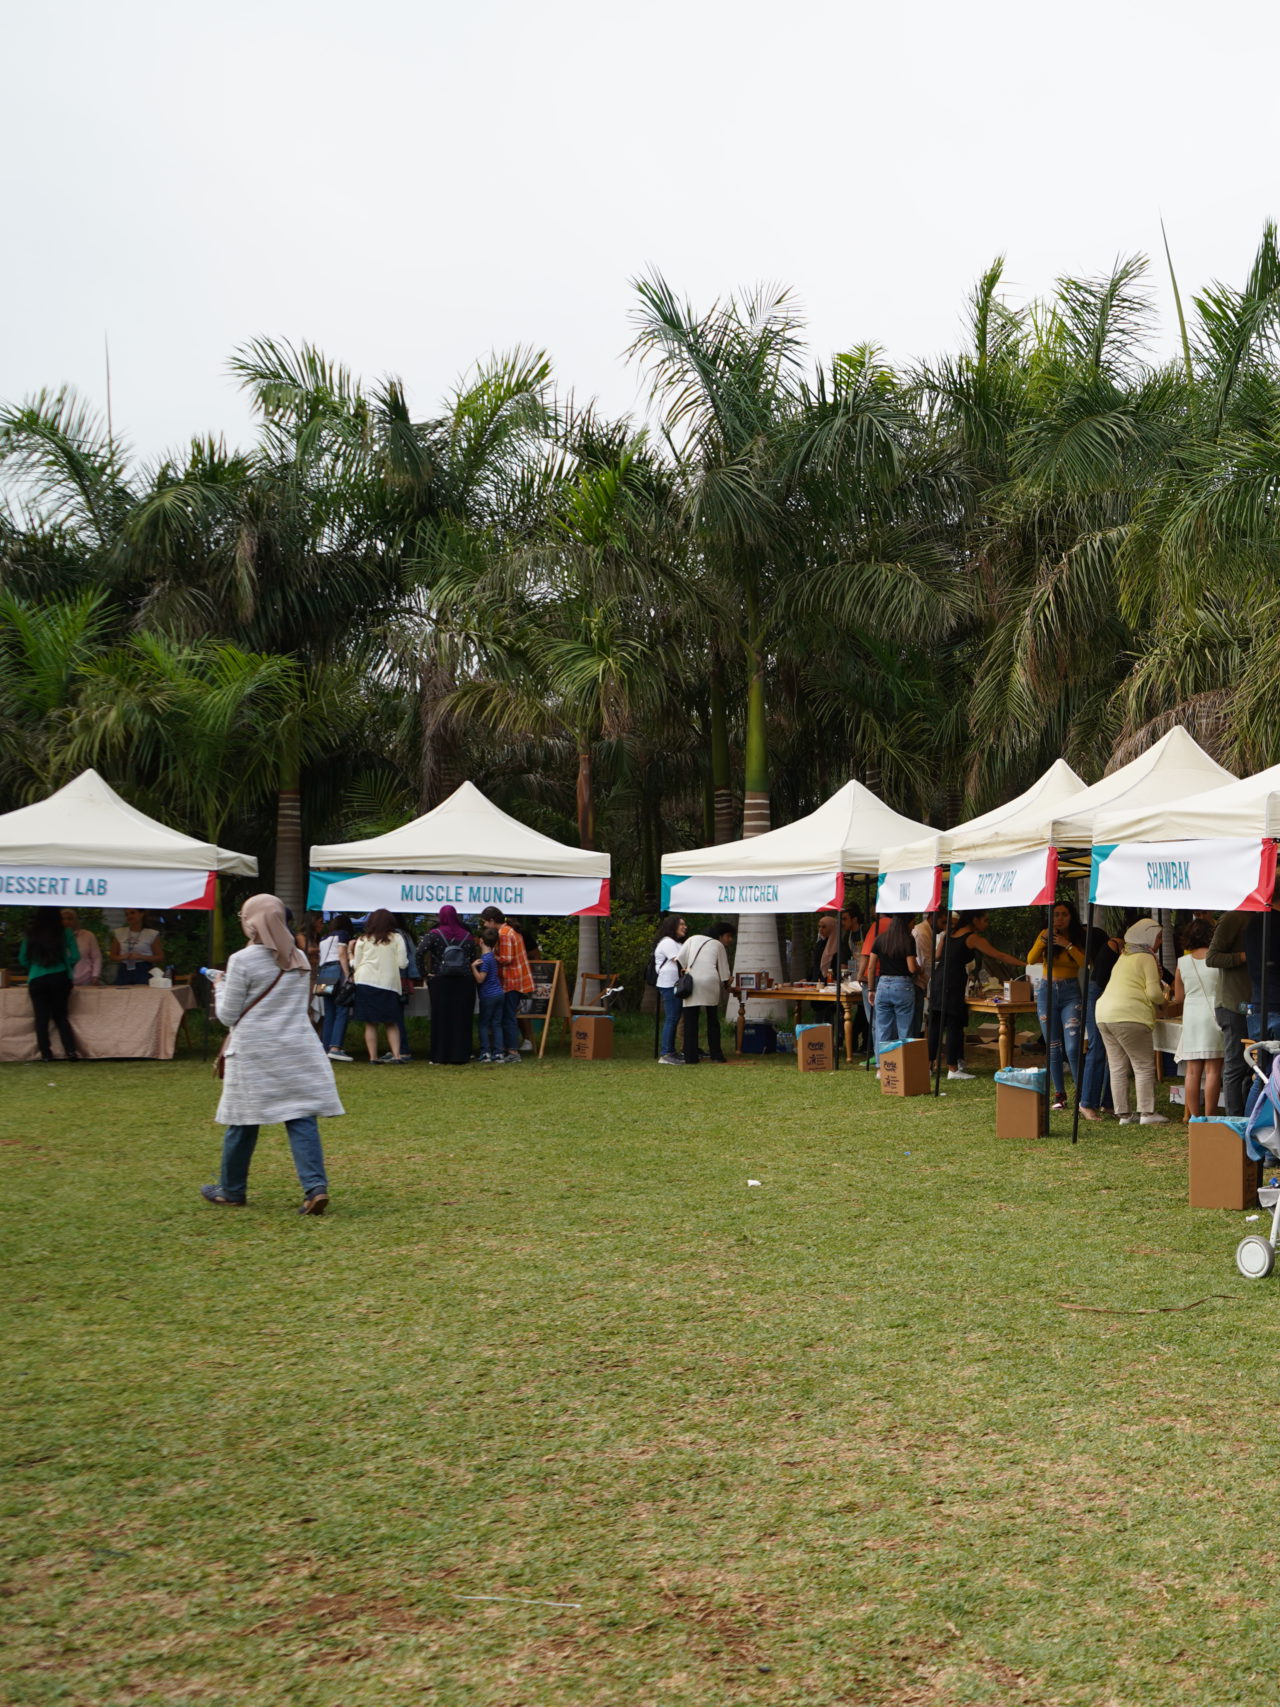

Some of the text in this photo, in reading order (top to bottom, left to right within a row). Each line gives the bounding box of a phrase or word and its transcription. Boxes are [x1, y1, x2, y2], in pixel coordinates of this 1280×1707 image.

[1146, 861, 1191, 890] SHAWBAK
[75, 878, 108, 896] LAB
[400, 884, 524, 904] MUSCLE MUNCH
[718, 884, 779, 902] ZAD KITCHEN
